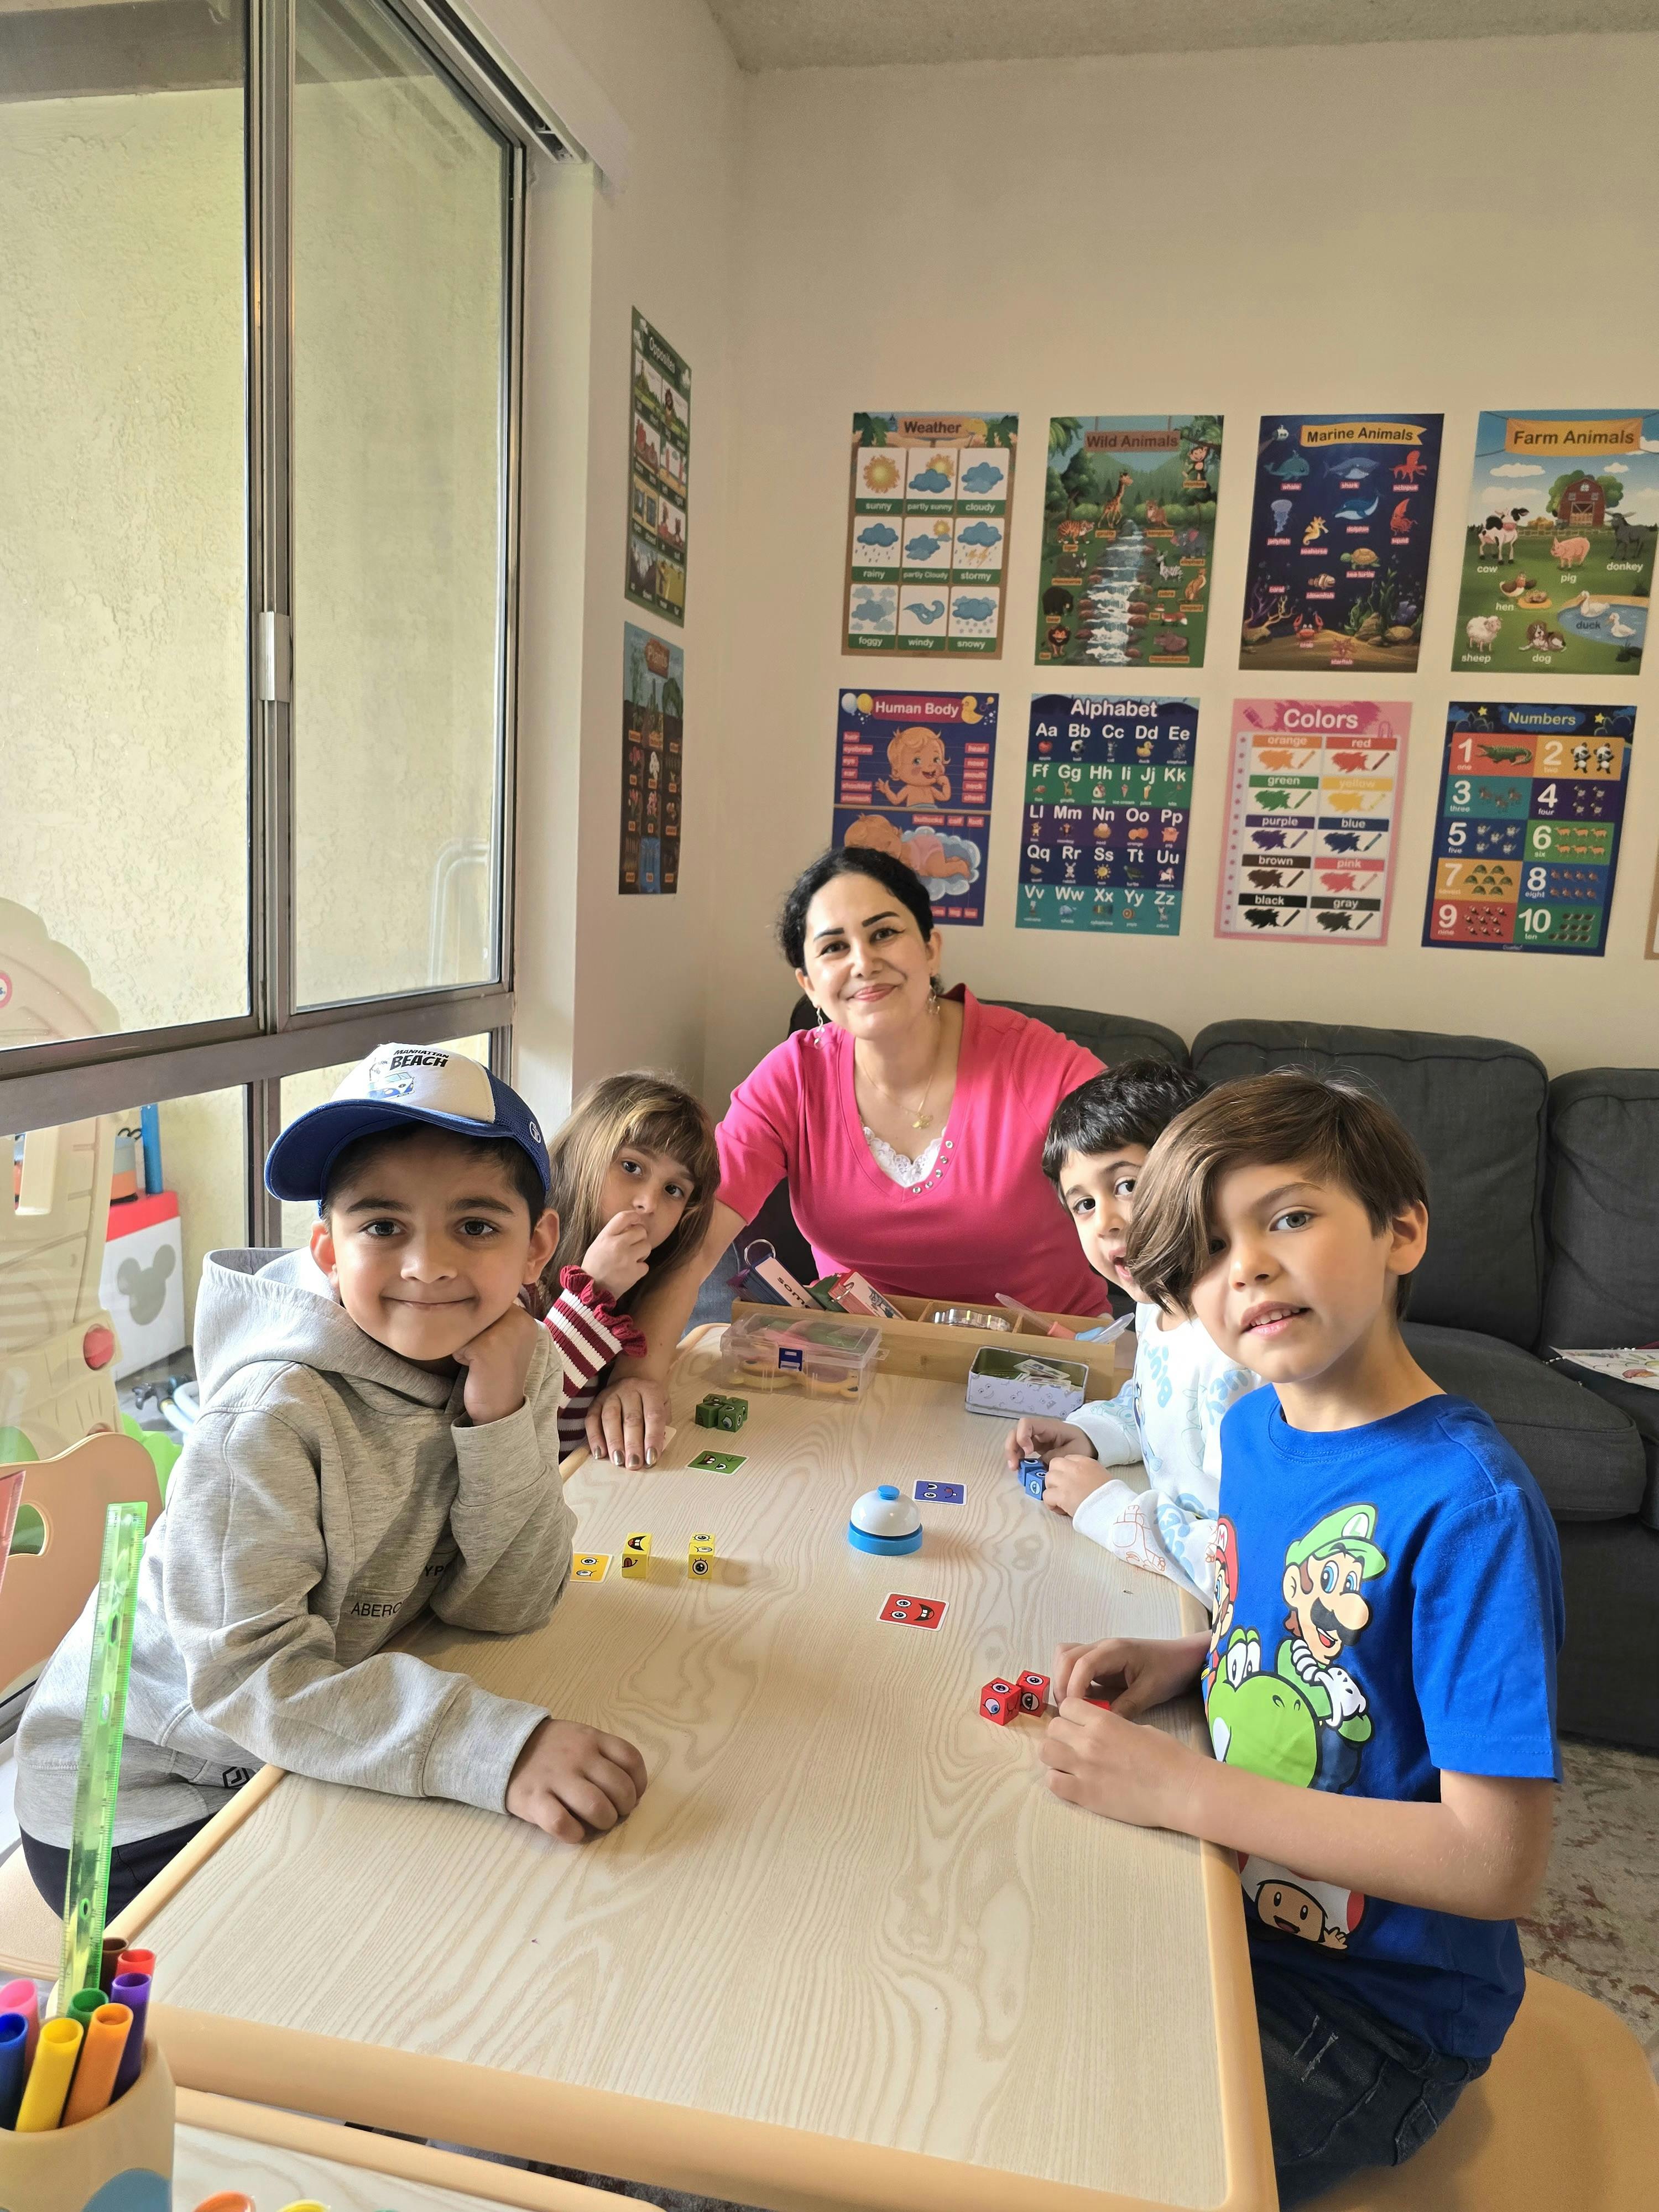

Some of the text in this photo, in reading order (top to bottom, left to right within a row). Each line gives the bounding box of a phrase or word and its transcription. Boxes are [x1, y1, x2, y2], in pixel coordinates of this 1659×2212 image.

[904, 421, 962, 434] Weather
[1307, 427, 1413, 442] Marine Animals
[1514, 430, 1634, 445] Farm Animals
[1087, 435, 1178, 448] Wild Animals
[866, 502, 892, 512] sunny
[907, 502, 952, 512] partly sunny
[966, 503, 995, 512] cloudy
[1606, 562, 1643, 572] donkey
[863, 569, 885, 579] rainy
[961, 572, 991, 582] stormy
[1561, 574, 1577, 584] pig
[1496, 602, 1514, 611] hen
[1577, 621, 1600, 630] duck
[858, 637, 883, 647] foggy
[908, 638, 934, 648] windy
[957, 640, 985, 650] snowy
[1462, 654, 1491, 664] sheep
[1532, 654, 1552, 664] dog
[875, 701, 959, 718] Human Body
[1071, 699, 1157, 719] Alphabet
[1283, 708, 1359, 729] Colors
[1508, 712, 1576, 726] Numbers
[1035, 722, 1190, 740] Aa Bb Cc Dd Ee
[1267, 736, 1307, 747] orange
[1352, 738, 1371, 748] red
[1458, 738, 1473, 763] 1
[1543, 740, 1563, 765] 2
[1032, 764, 1049, 778] Ff
[1058, 764, 1081, 782] Gg
[1089, 765, 1112, 780] Hh
[1140, 767, 1156, 784] Jj
[1164, 768, 1186, 782] Kk
[1267, 776, 1300, 786] green
[1339, 778, 1376, 789] yellow
[1452, 780, 1471, 805] 3
[1537, 783, 1558, 808] 4
[1053, 806, 1082, 820] Mm
[1092, 807, 1115, 821] Nn
[1126, 807, 1150, 822] Oo
[1161, 809, 1183, 826] Pp
[1262, 816, 1298, 828] purple
[1341, 818, 1366, 828] blue
[1447, 822, 1467, 846] 5
[1532, 825, 1552, 849] 6
[1027, 845, 1179, 864] Qq Rr Ss Tt Uu
[1259, 855, 1293, 866] brown
[1337, 859, 1361, 869] pink
[1444, 863, 1463, 886] 7
[1527, 867, 1547, 891] 8
[1024, 885, 1175, 907] Vv Ww Xx Yy Zz
[1255, 895, 1285, 905] black
[1333, 901, 1358, 911] gray
[1439, 904, 1457, 928] 9
[1518, 908, 1551, 933] 10
[394, 1049, 449, 1058] MANHATTAN
[389, 1055, 448, 1071] BEACH
[1349, 1516, 1362, 1535] L
[1218, 1529, 1224, 1548] M
